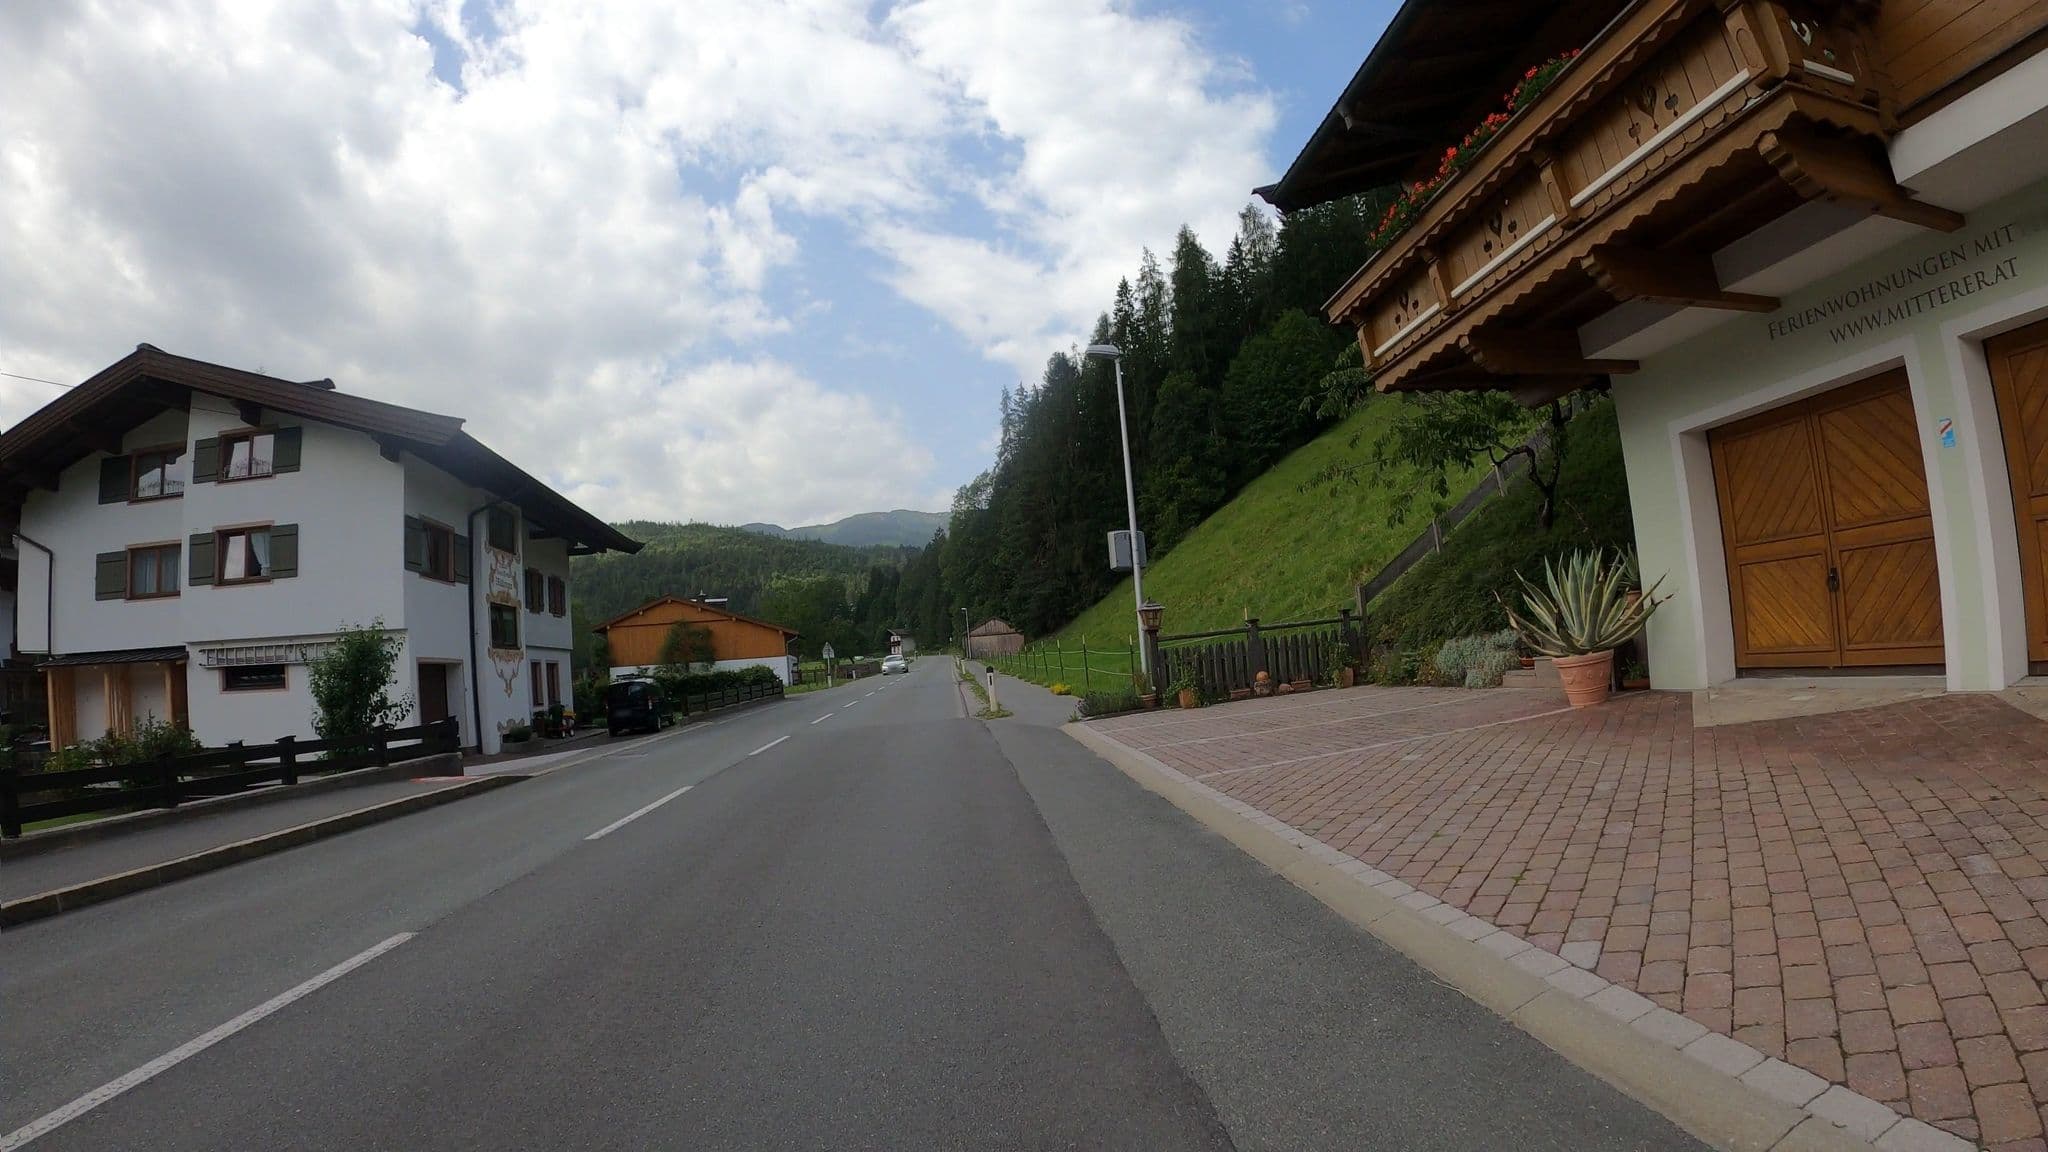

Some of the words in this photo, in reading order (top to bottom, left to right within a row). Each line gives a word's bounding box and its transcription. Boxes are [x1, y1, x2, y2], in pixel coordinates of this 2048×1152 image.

[1768, 245, 1968, 340] FERIENWOHNUNGEN
[1974, 223, 2016, 256] MIT
[1830, 257, 2019, 344] WWW.MITTERER.AT
